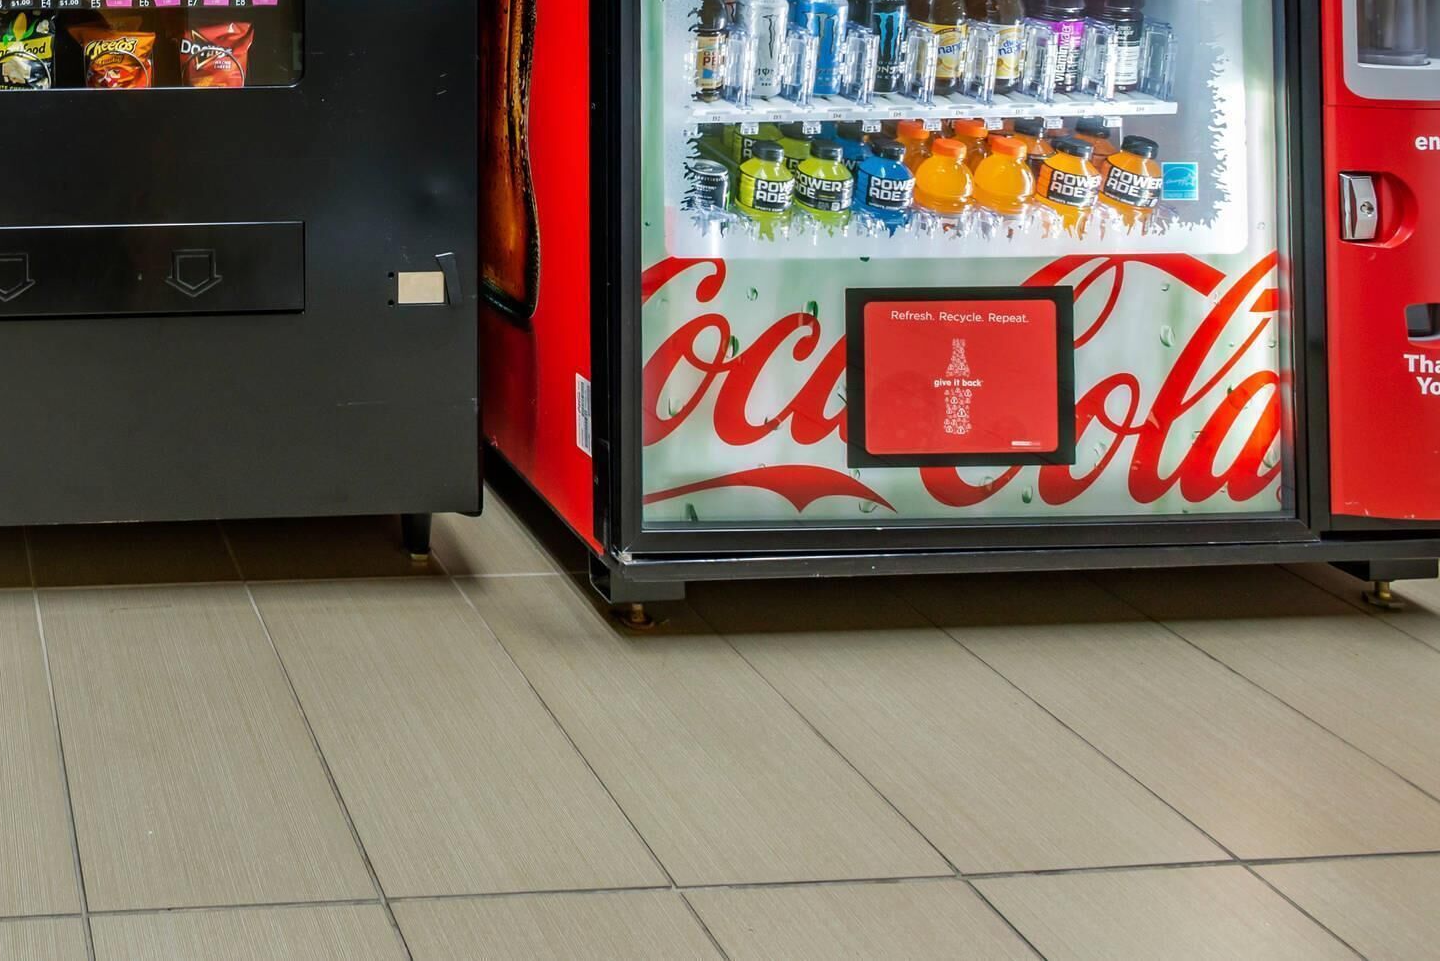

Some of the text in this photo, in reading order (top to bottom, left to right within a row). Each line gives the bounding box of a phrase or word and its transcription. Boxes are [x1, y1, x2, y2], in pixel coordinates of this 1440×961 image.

[11, 0, 31, 7] $1.00
[59, 0, 79, 7] $1.00
[85, 38, 137, 60] Cheetos
[181, 39, 233, 58] Doritos
[757, 178, 795, 193] POW
[1110, 167, 1162, 189] POWER
[869, 187, 900, 201] ADE
[1050, 182, 1084, 197] ADE
[1107, 179, 1139, 196] ADE
[891, 310, 1029, 324] Refresh. Recycle. Repeat.
[933, 378, 982, 387] give it back
